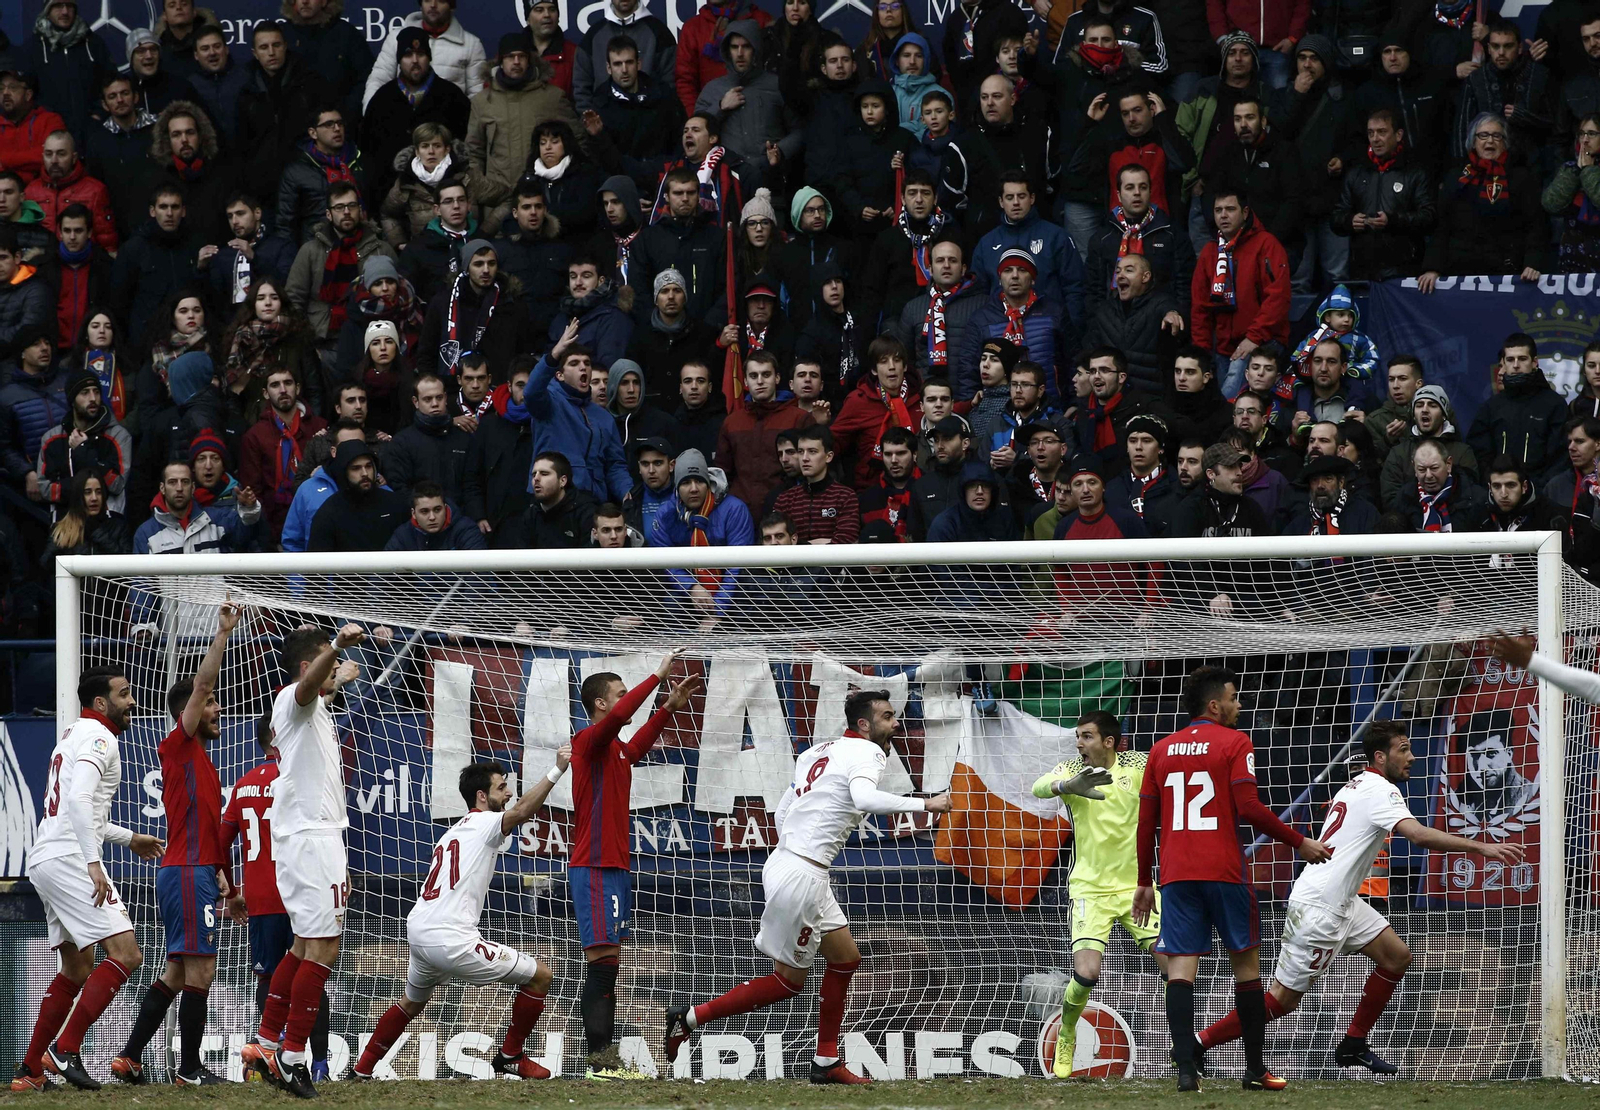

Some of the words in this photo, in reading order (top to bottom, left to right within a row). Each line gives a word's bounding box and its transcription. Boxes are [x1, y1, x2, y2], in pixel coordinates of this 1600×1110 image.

[1164, 771, 1218, 831] 12
[716, 816, 768, 850] TA
[422, 838, 460, 901] 21
[204, 904, 214, 928] 6
[611, 895, 619, 918] 3
[798, 926, 813, 947] 8
[1309, 949, 1334, 970] 22
